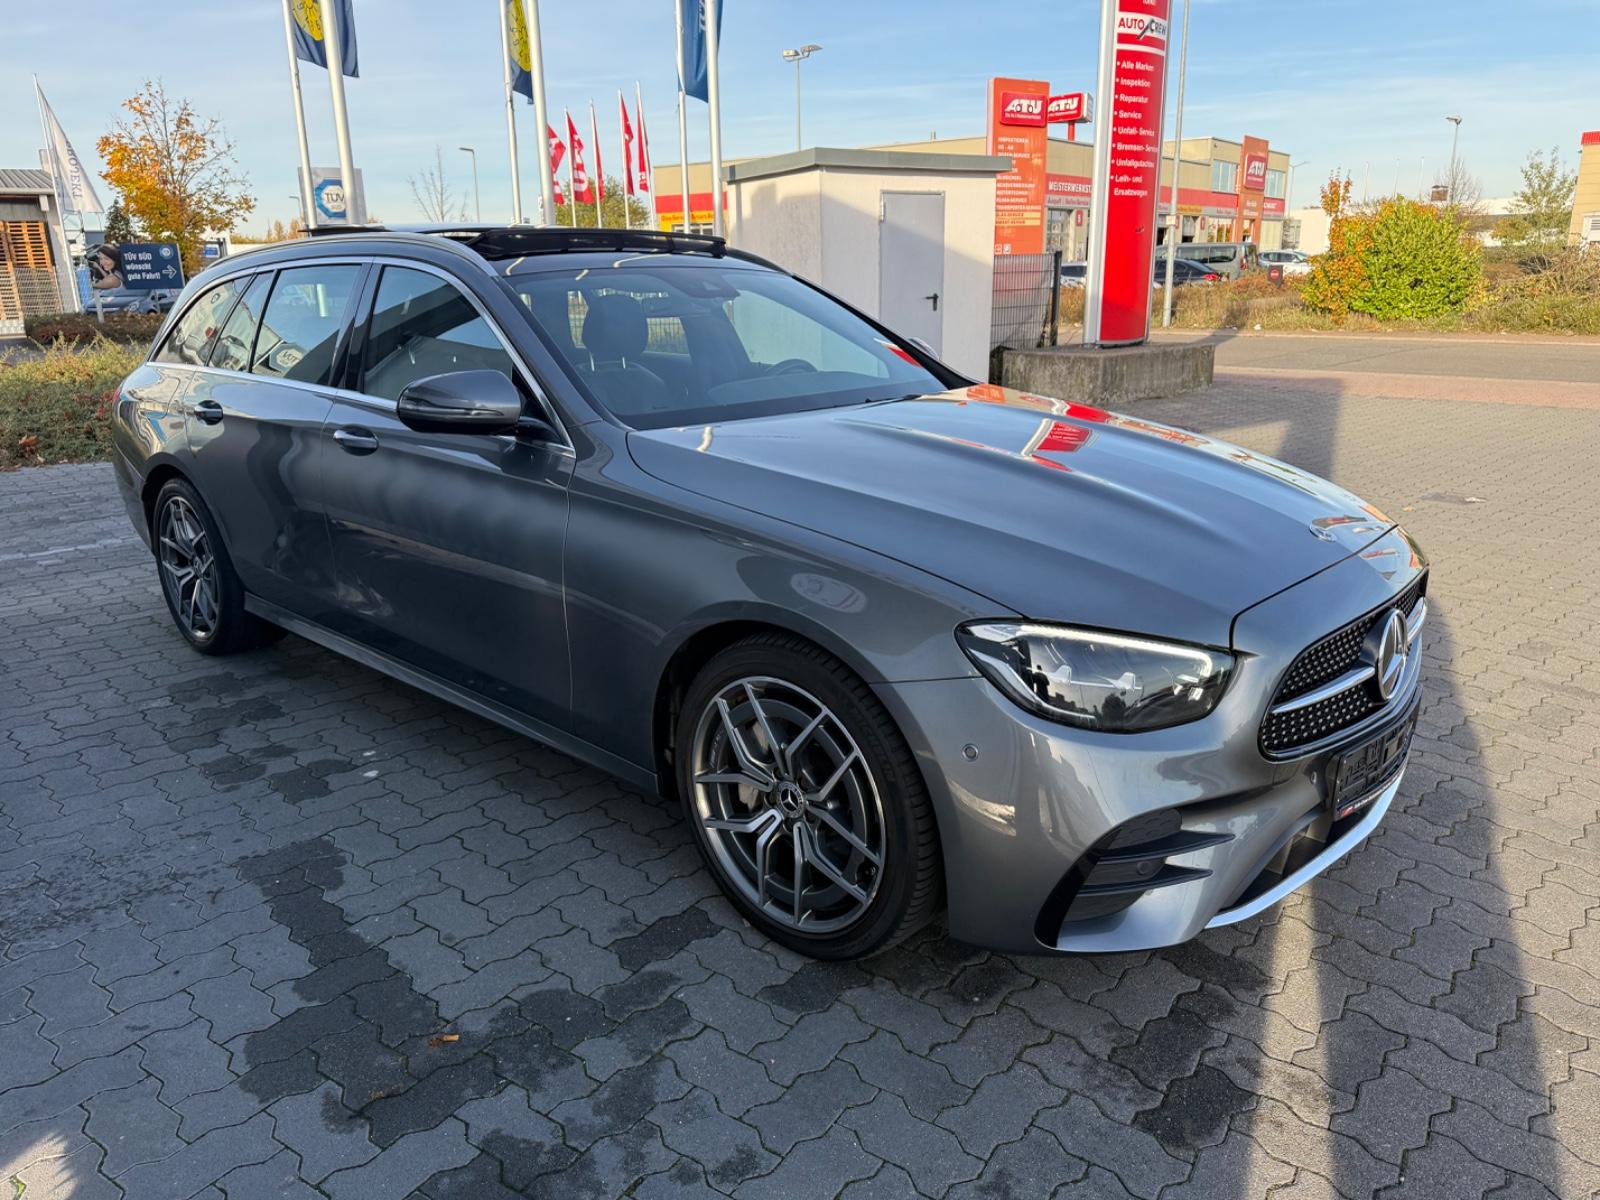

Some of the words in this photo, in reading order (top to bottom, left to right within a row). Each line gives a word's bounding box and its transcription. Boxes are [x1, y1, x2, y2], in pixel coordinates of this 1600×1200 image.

[1118, 17, 1145, 30] AUTO
[1121, 60, 1134, 69] Alle
[1120, 93, 1149, 103] Reparatur
[1118, 110, 1142, 120] Service
[124, 251, 137, 261] TÜV
[138, 251, 152, 261] SÜD
[125, 262, 152, 270] wünscht
[127, 273, 141, 281] gute
[142, 271, 161, 280] Fahrt!
